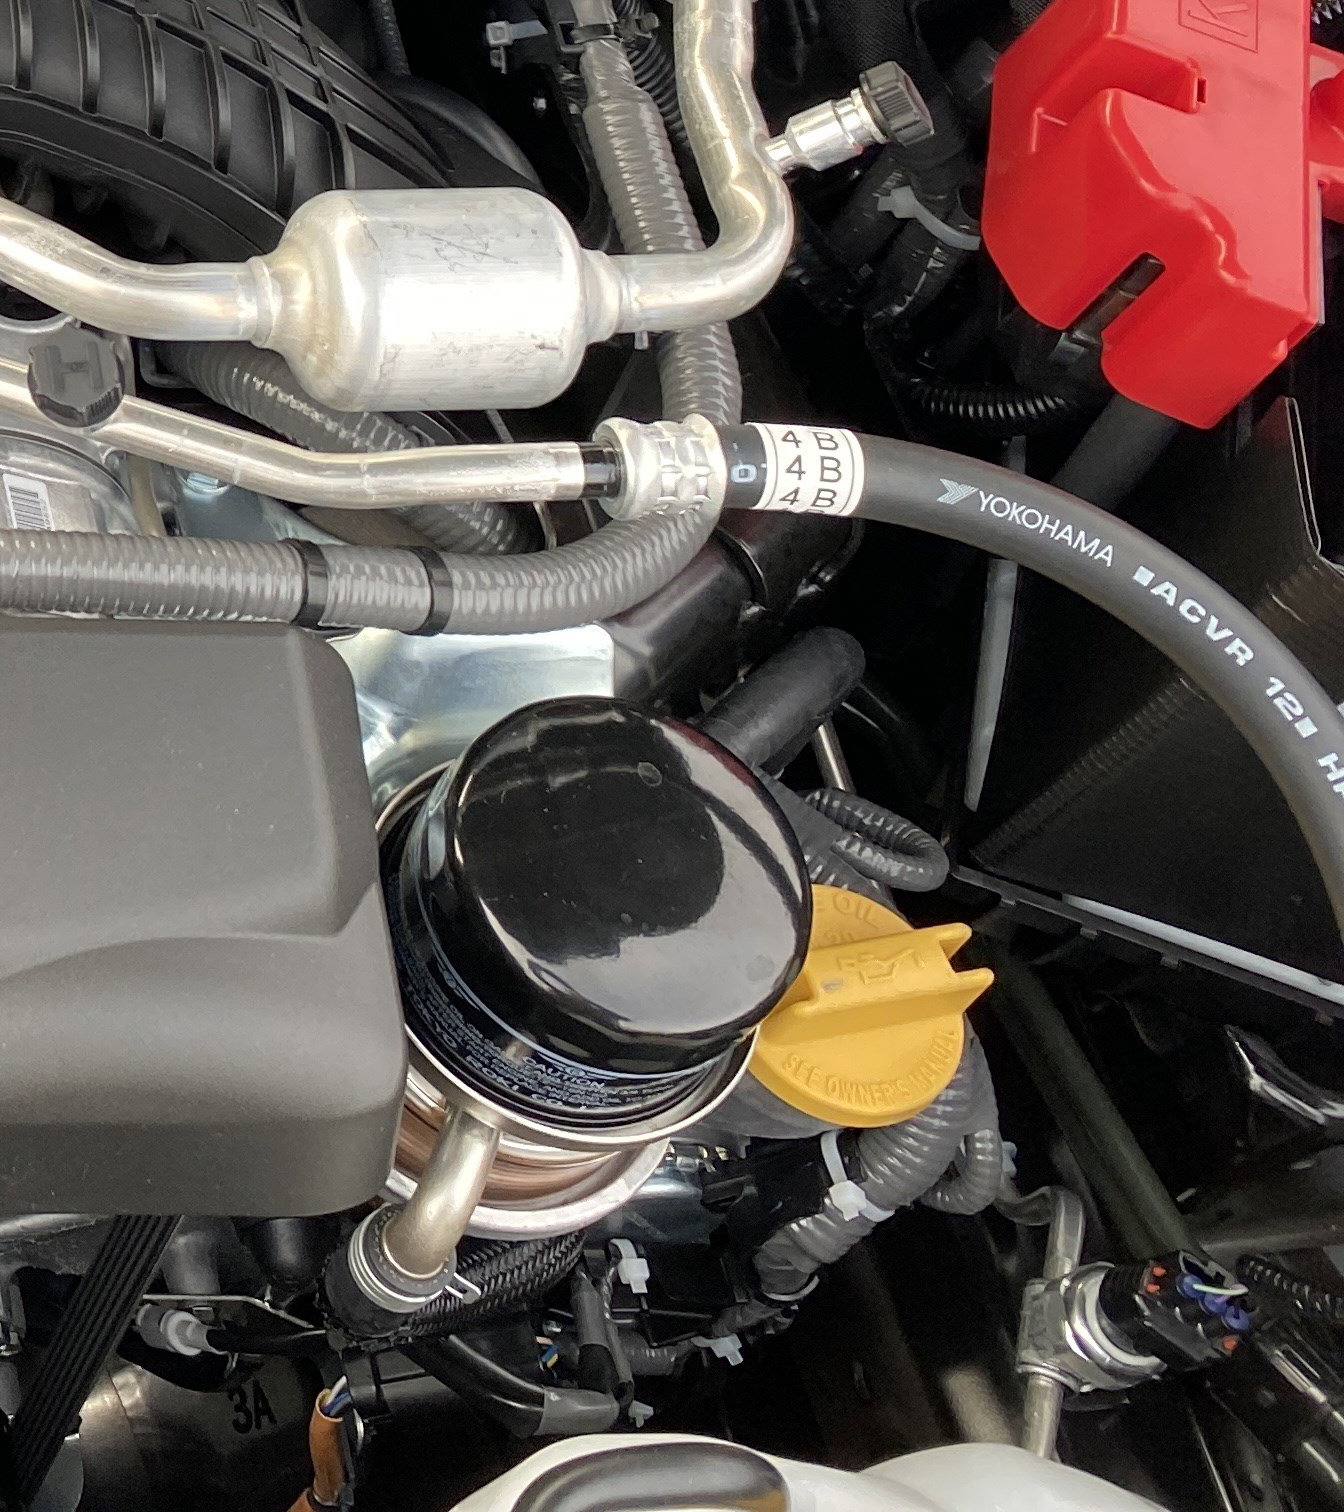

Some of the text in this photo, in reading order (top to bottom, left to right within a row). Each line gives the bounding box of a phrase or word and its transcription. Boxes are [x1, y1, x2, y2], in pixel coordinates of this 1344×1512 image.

[976, 489, 1114, 568] YOKOHAMA
[1150, 581, 1255, 667] ACVR
[464, 1053, 521, 1093] ROKI
[521, 1055, 607, 1090] CAUTION
[227, 1375, 278, 1434] 3A
